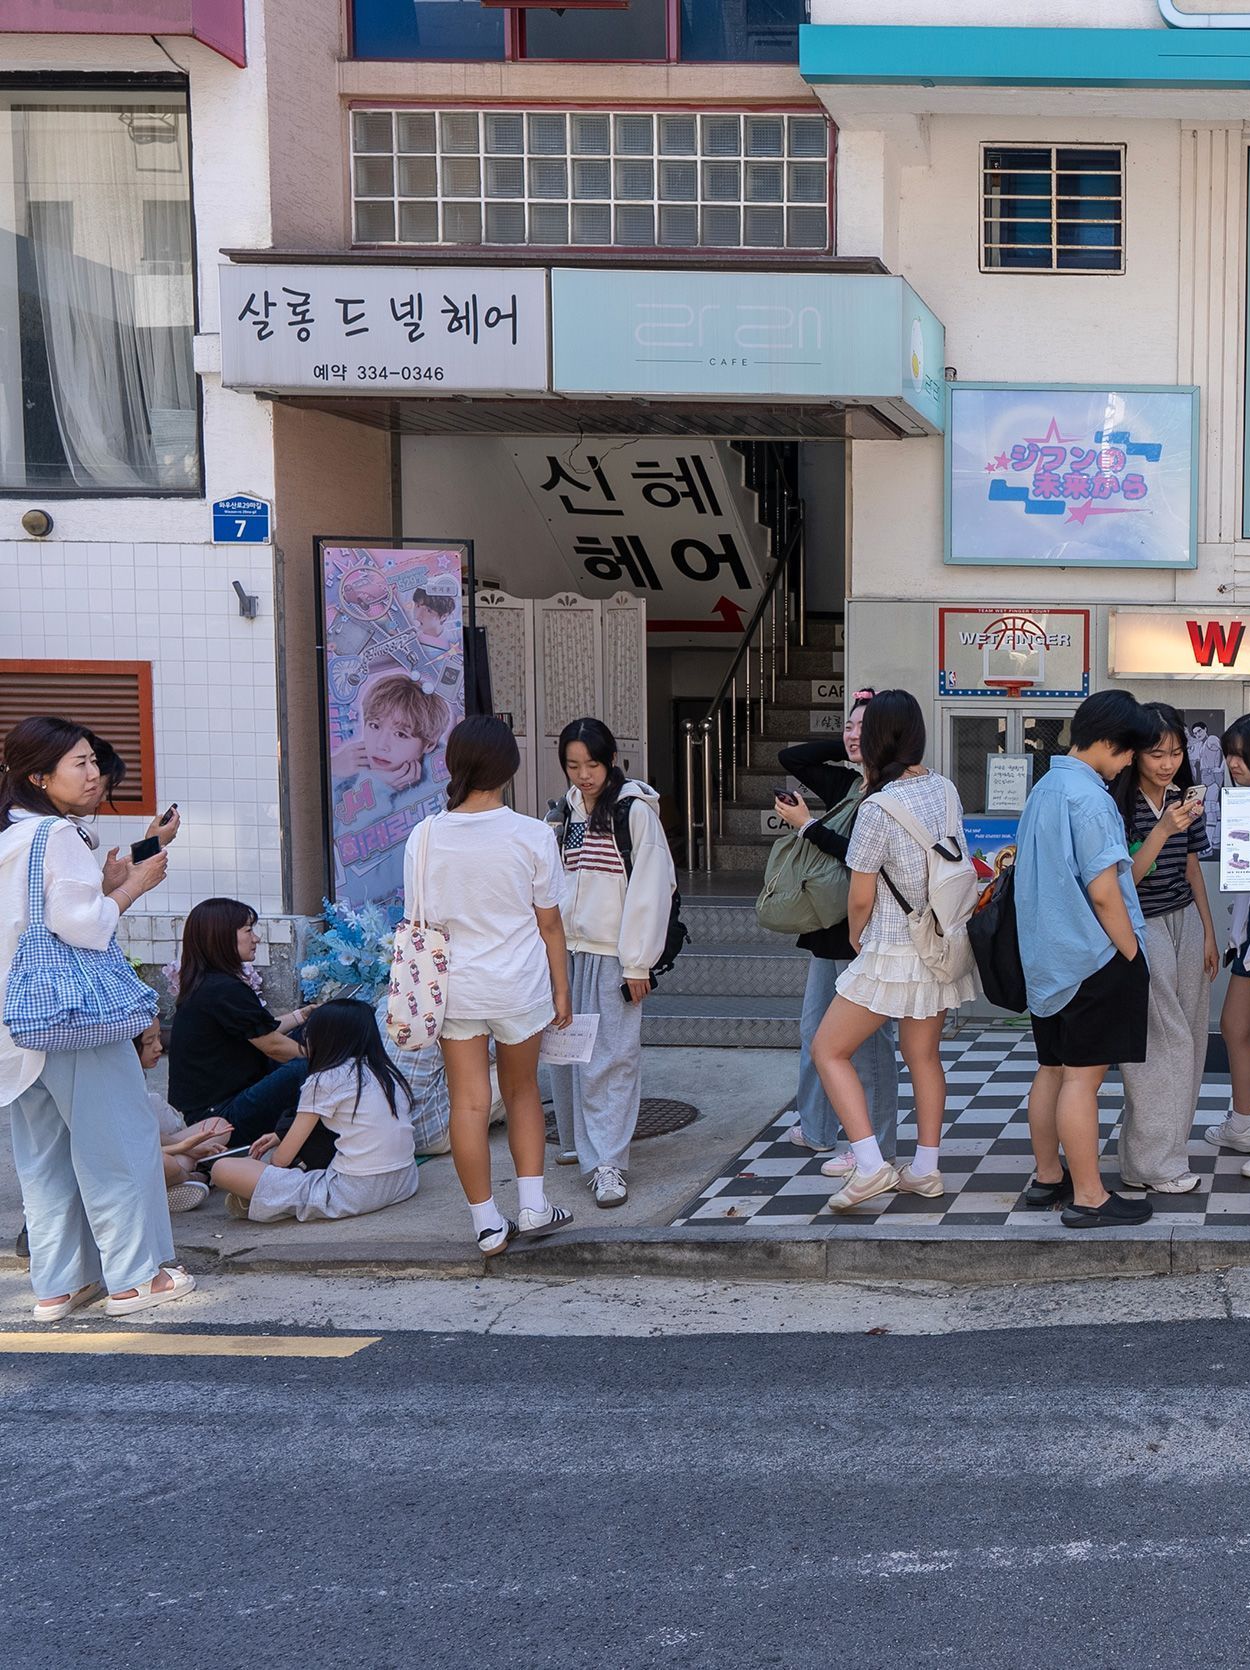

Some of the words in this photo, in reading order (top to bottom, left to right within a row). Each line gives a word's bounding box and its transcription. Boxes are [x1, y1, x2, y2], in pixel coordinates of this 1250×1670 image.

[238, 286, 315, 342] 살롱
[334, 297, 370, 337] 드
[390, 291, 425, 343] 넬
[440, 293, 517, 345] 헤어
[313, 364, 348, 381] 예약
[357, 365, 445, 381] 334-0346
[709, 357, 748, 367] CAFE
[1011, 443, 1126, 473] ジフンの
[1032, 473, 1148, 500] 未来から
[234, 520, 247, 537] 7
[573, 533, 753, 591] 헤어
[959, 631, 1002, 646] WET
[1005, 633, 1072, 648] FINGER
